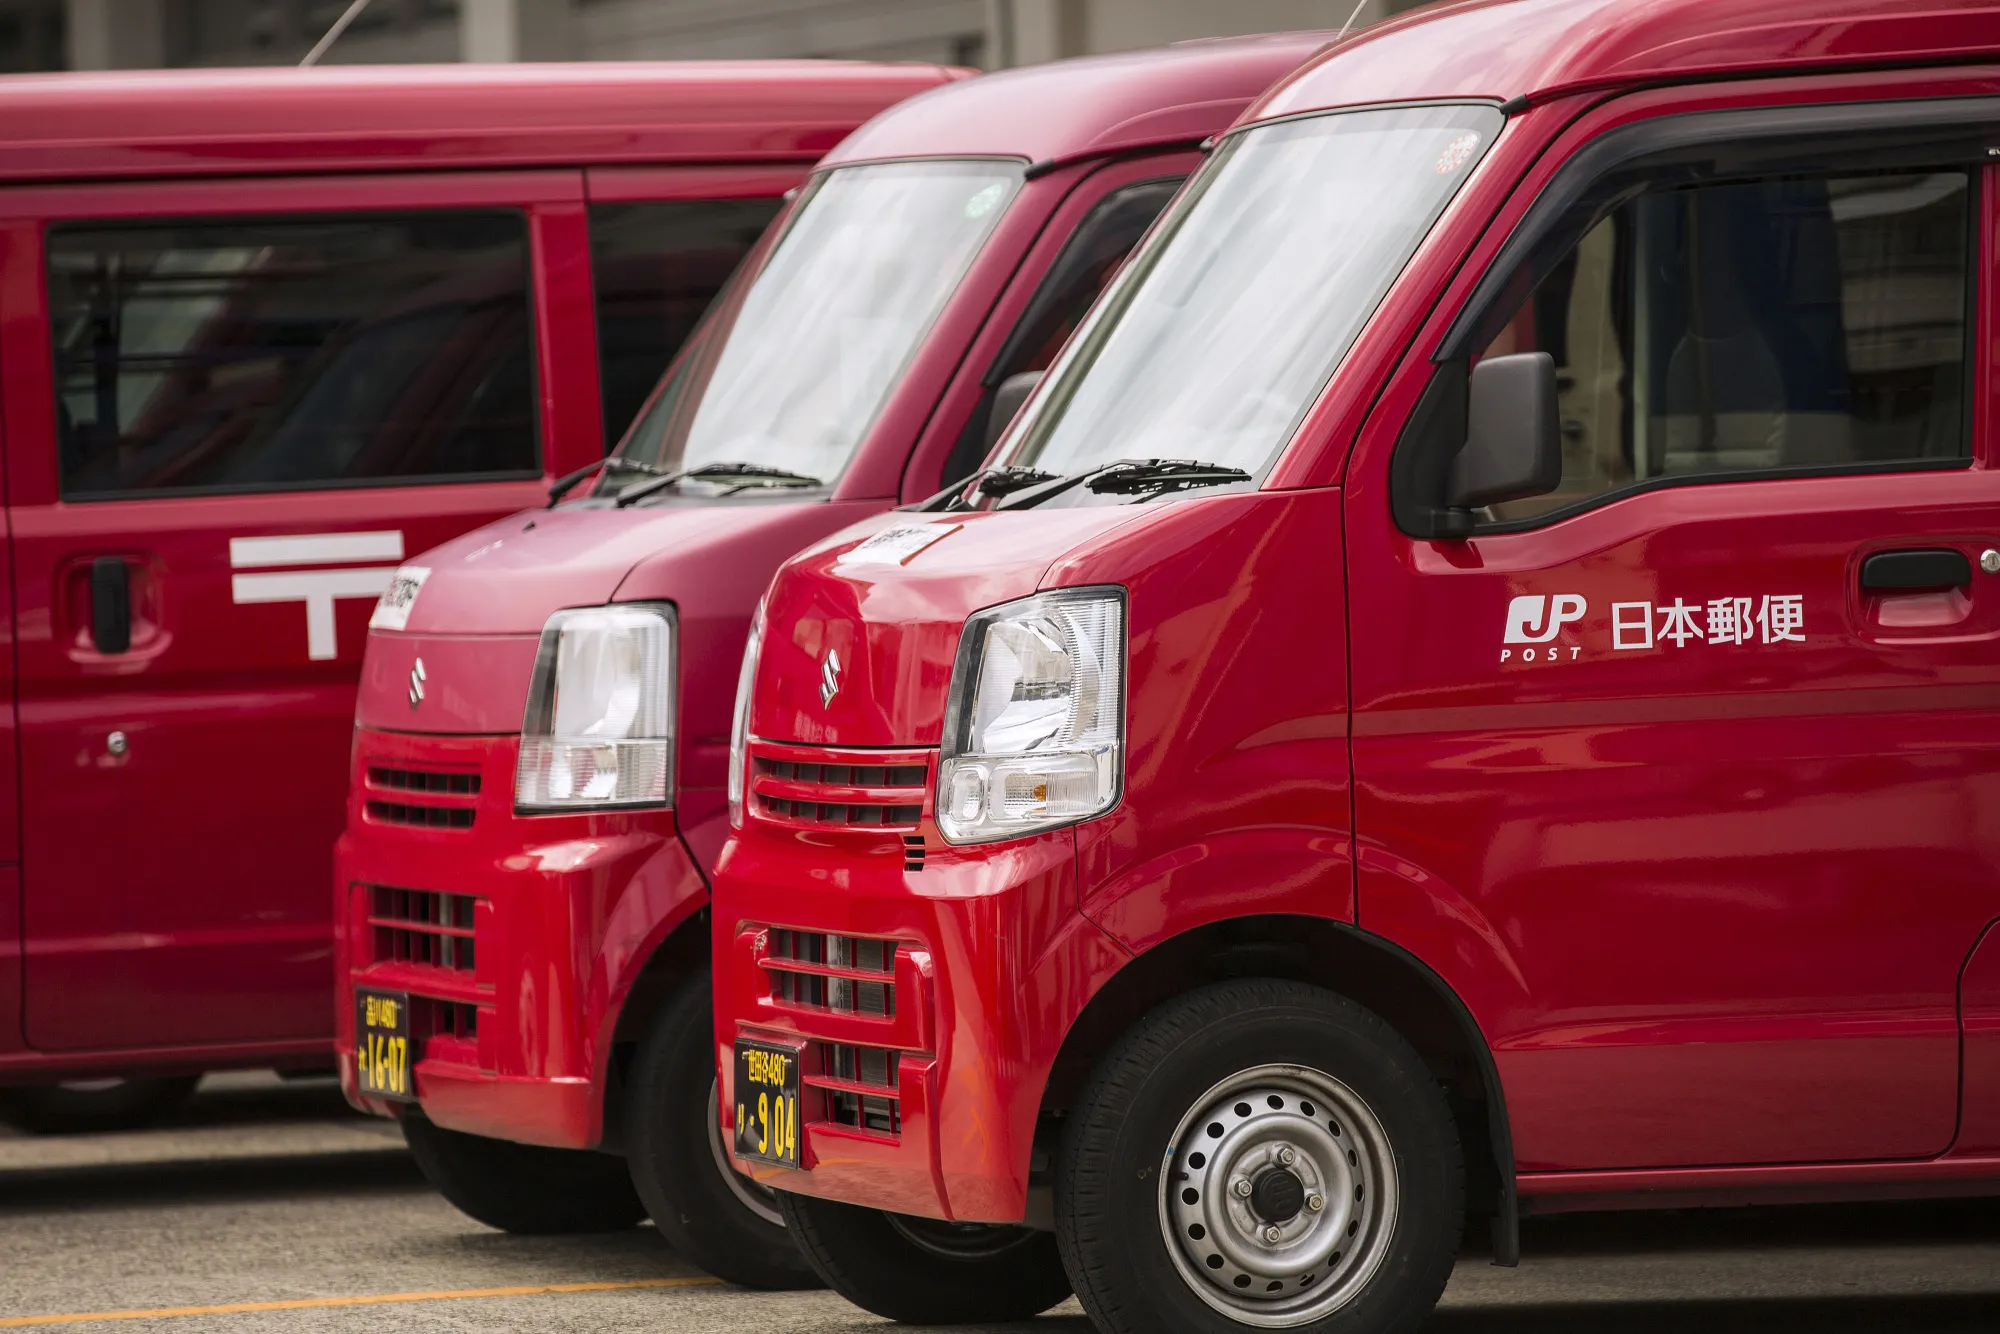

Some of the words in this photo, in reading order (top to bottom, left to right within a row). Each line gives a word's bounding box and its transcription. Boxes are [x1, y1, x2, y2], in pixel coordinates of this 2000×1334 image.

[1504, 594, 1587, 643] JP
[1611, 594, 1806, 650] 日本郵便
[1501, 647, 1582, 662] POST
